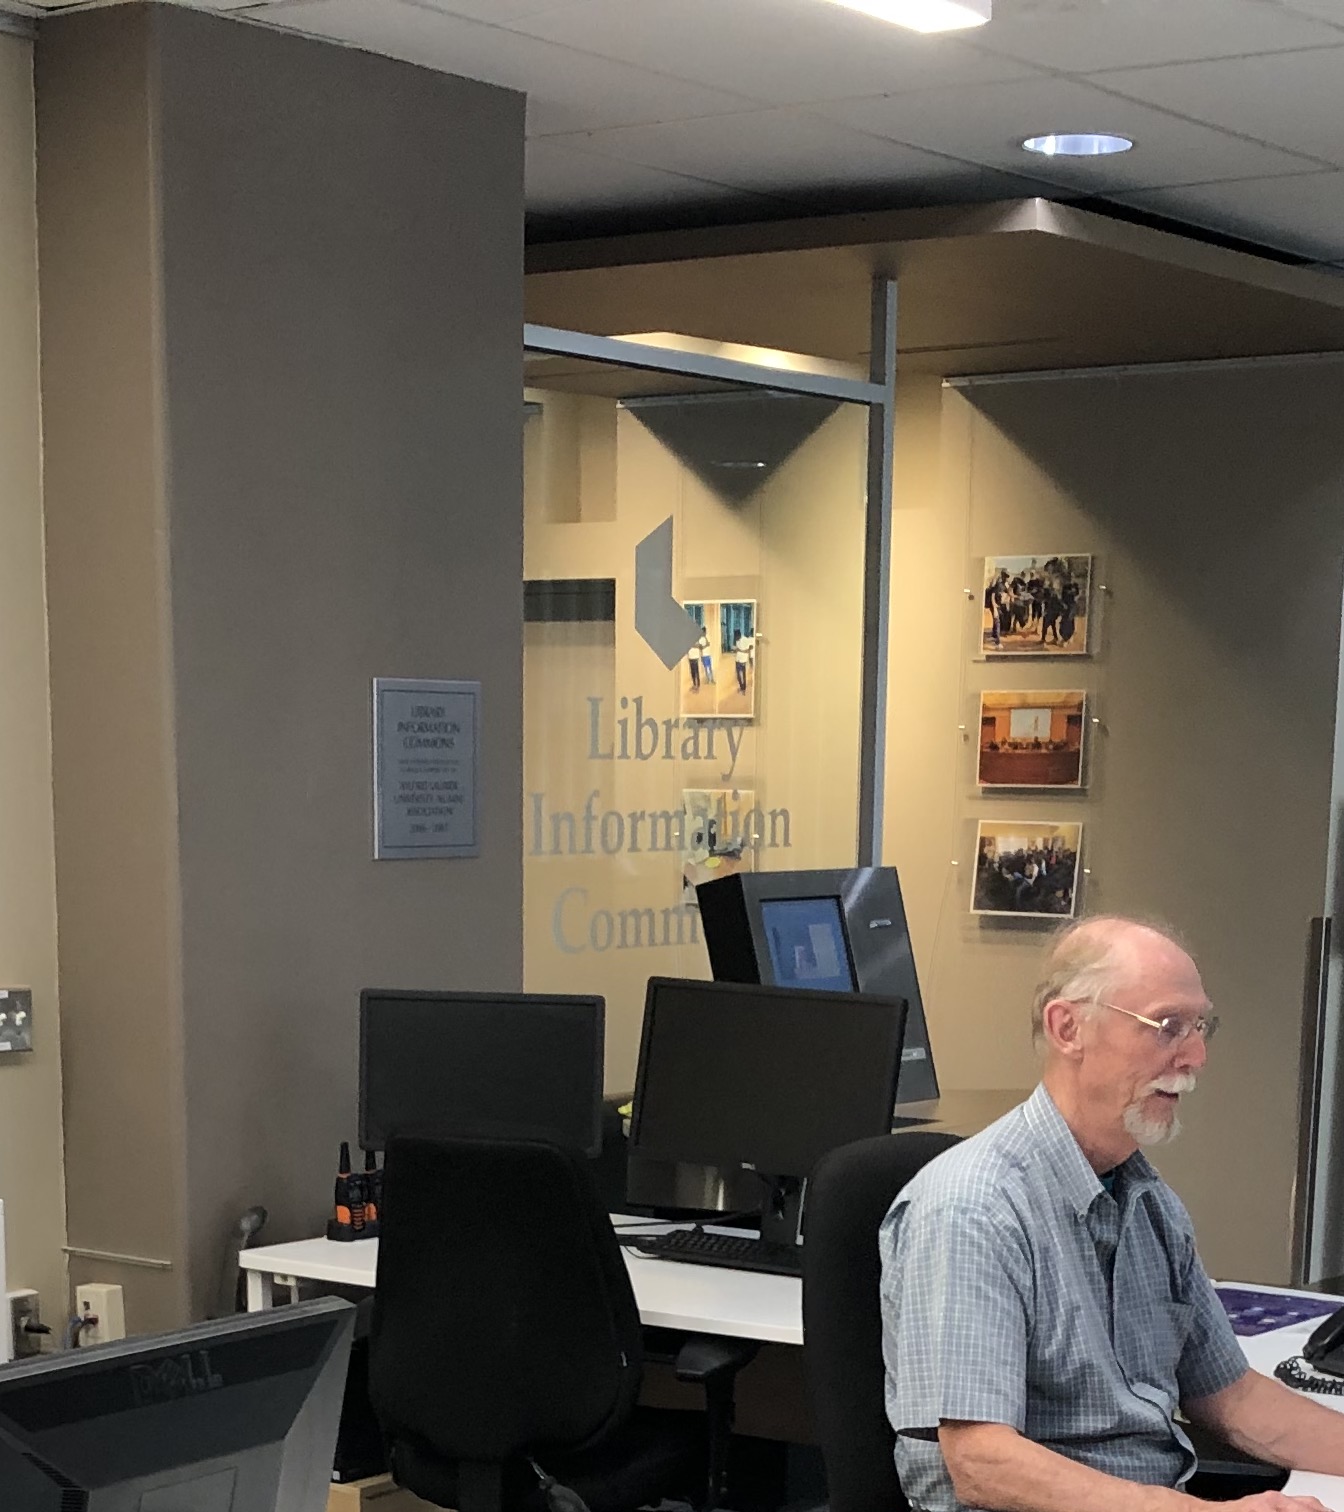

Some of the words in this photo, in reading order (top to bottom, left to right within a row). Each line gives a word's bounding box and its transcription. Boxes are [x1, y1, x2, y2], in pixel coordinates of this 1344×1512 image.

[587, 696, 745, 781] Library
[528, 789, 792, 856] Information
[552, 886, 700, 954] Comm
